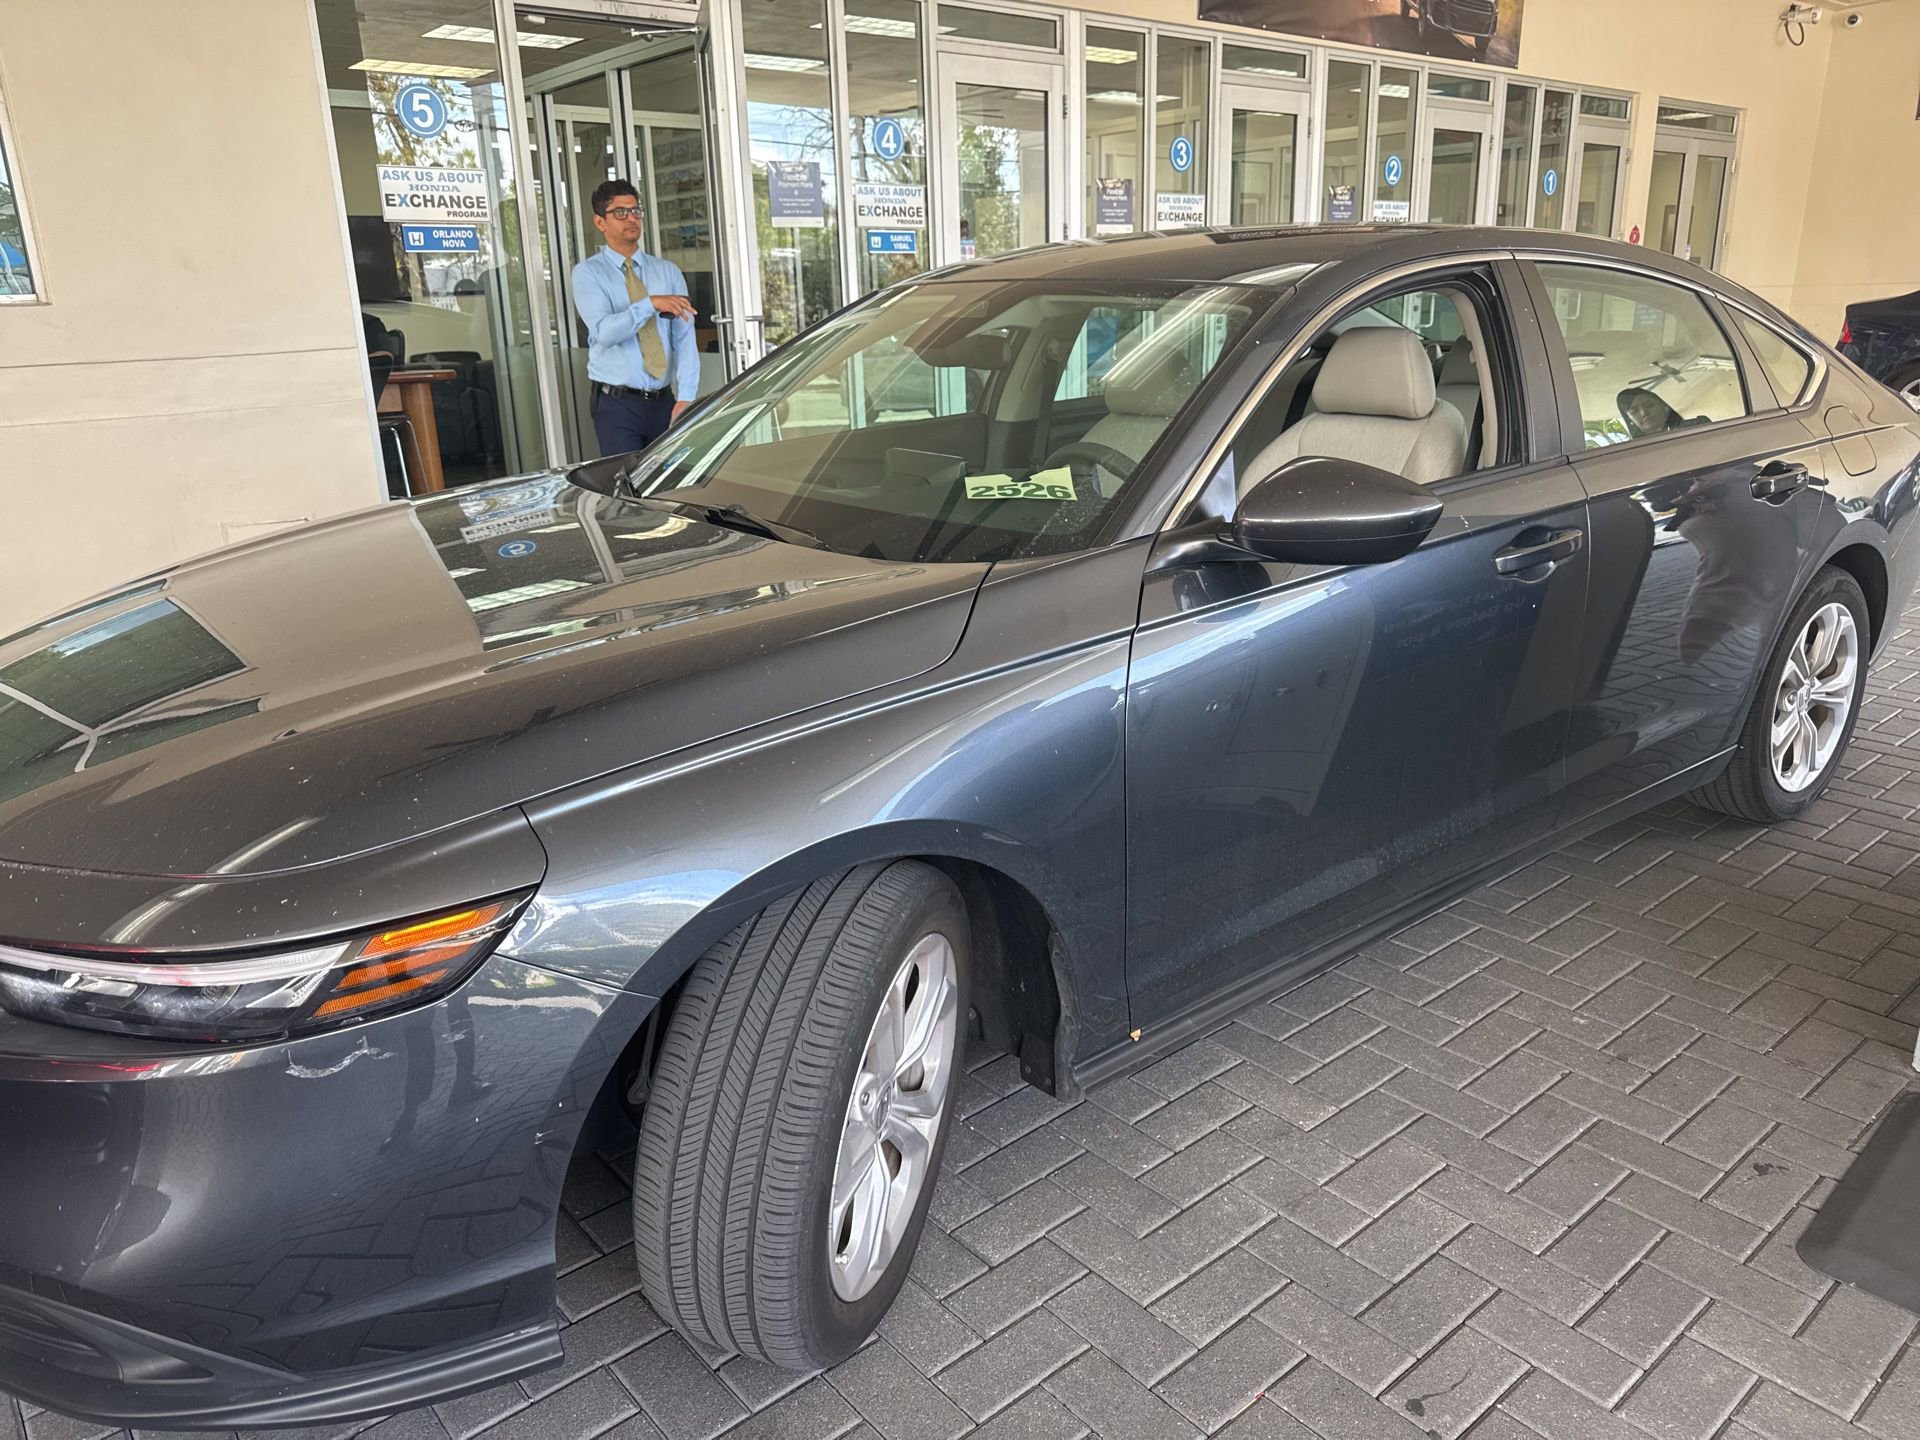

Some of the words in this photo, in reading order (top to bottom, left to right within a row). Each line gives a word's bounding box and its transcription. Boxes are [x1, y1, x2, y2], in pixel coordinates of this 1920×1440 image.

[412, 92, 435, 128] 5
[881, 125, 897, 154] 4
[1176, 141, 1187, 167] 3
[1389, 159, 1398, 181] 2
[382, 169, 411, 181] ASK
[415, 171, 434, 182] US
[438, 172, 484, 184] ABOUT
[408, 184, 461, 193] HONDA
[1548, 174, 1553, 192] 1
[857, 186, 876, 196] ASK
[878, 187, 890, 196] US
[892, 187, 922, 197] ABOUT
[385, 193, 488, 210] EXCHANGE
[1172, 196, 1181, 204] US
[1182, 196, 1204, 205] ABOUT
[447, 210, 488, 218] PROGRAM
[858, 205, 923, 218] EXCHANGE
[1157, 211, 1203, 222] EXCHANGE
[432, 229, 474, 239] ORLANDO
[890, 234, 913, 243] SAMUEL
[442, 239, 466, 248] NOVA
[893, 242, 911, 250] VIDAL
[970, 482, 1072, 499] 2526
